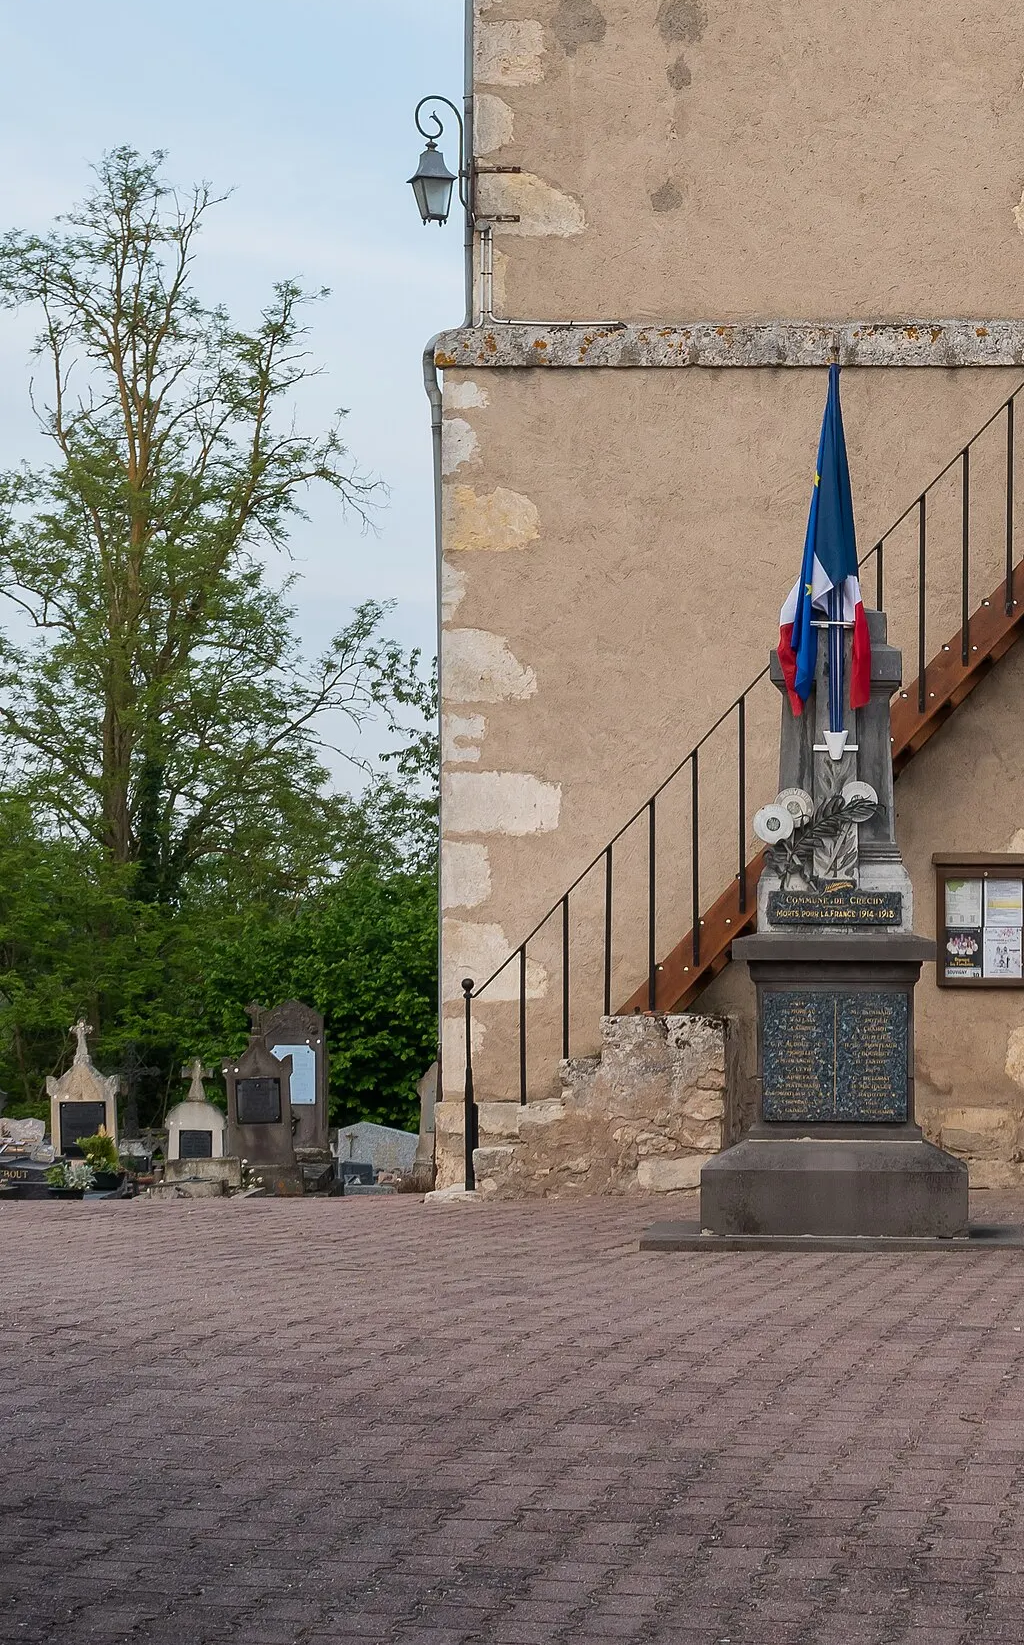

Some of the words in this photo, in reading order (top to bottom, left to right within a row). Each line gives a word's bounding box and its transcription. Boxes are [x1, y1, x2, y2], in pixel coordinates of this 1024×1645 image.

[786, 896, 828, 904] COMMUNE
[830, 909, 856, 918] FRANCE
[0, 1170, 29, 1179] BOUT
